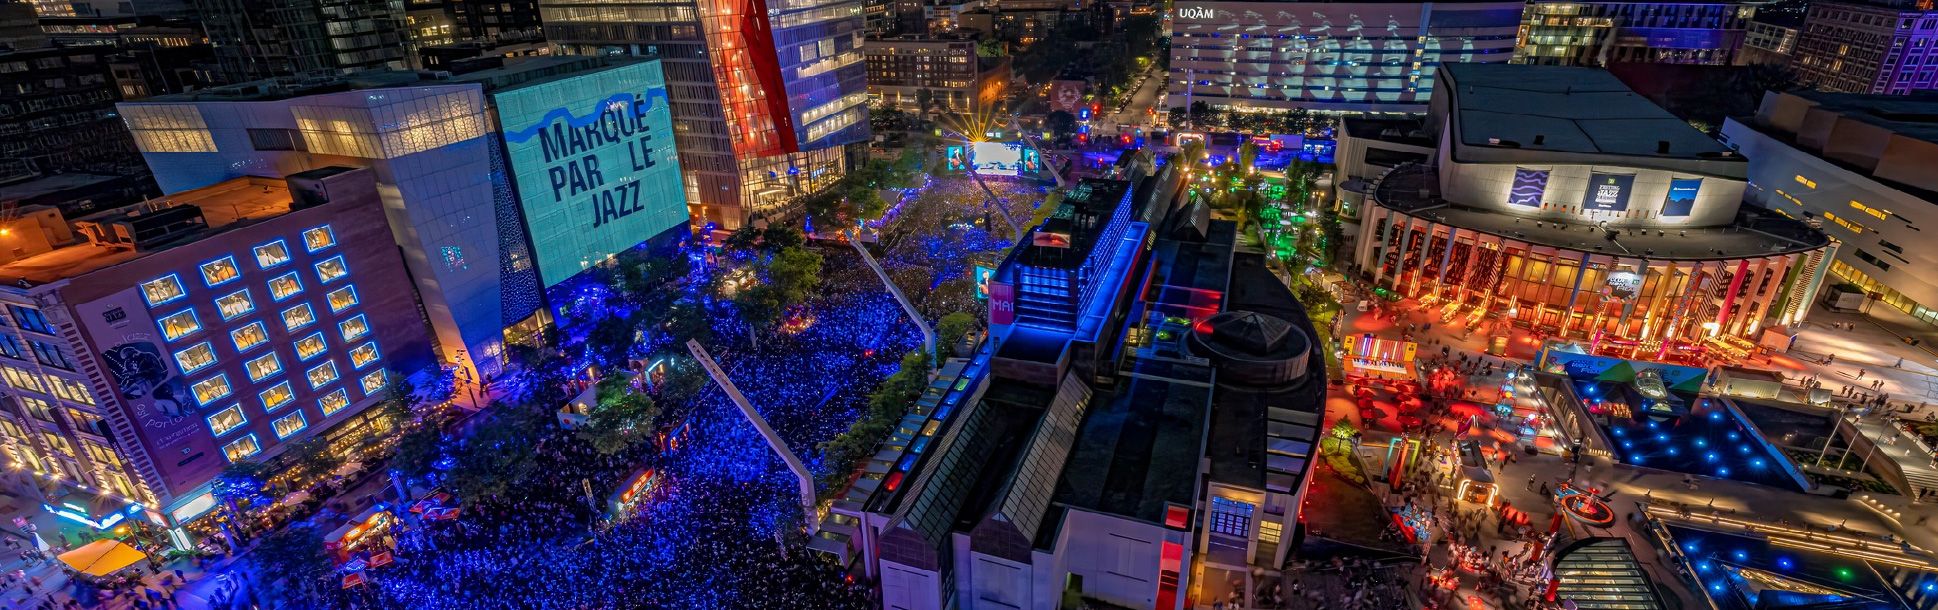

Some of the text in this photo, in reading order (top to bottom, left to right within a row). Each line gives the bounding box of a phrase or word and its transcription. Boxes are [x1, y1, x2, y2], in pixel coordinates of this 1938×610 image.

[1180, 6, 1214, 19] UQÀM
[537, 93, 650, 164] MARQUÉ
[548, 135, 656, 203] PAR LE
[1597, 190, 1619, 198] JAZZ
[592, 179, 645, 229] JAZZ
